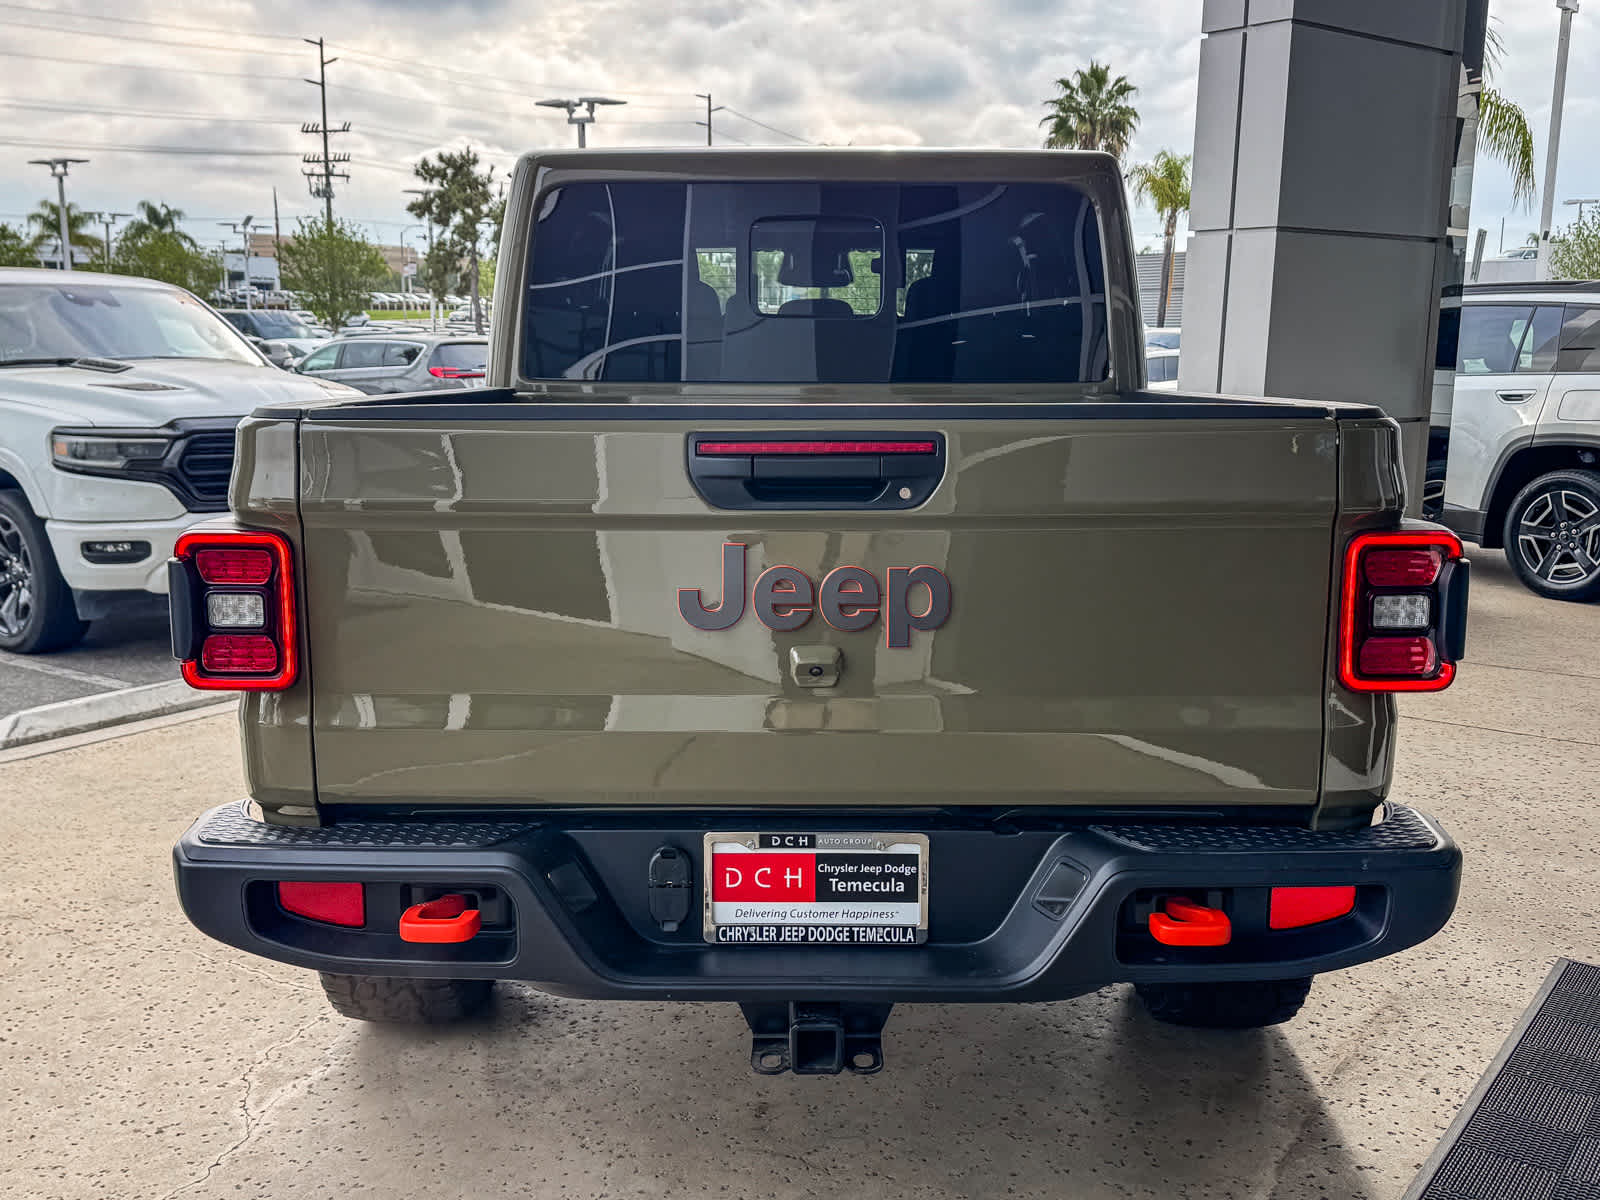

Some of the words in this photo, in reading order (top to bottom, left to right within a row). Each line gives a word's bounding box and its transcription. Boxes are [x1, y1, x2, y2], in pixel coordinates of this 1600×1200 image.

[677, 543, 951, 648] Jeep
[818, 837, 842, 845] AUTO
[818, 864, 858, 875] Chrysler
[859, 864, 882, 875] Jeep
[885, 864, 917, 875] Dodge
[725, 867, 802, 888] DCH
[829, 878, 905, 892] Temecula
[735, 908, 788, 920] Delivering
[790, 909, 839, 919] Customer
[841, 909, 895, 920] Happiness
[718, 926, 776, 942] CHRYSLER
[779, 927, 806, 942] JEEP
[808, 927, 850, 942] DODGE
